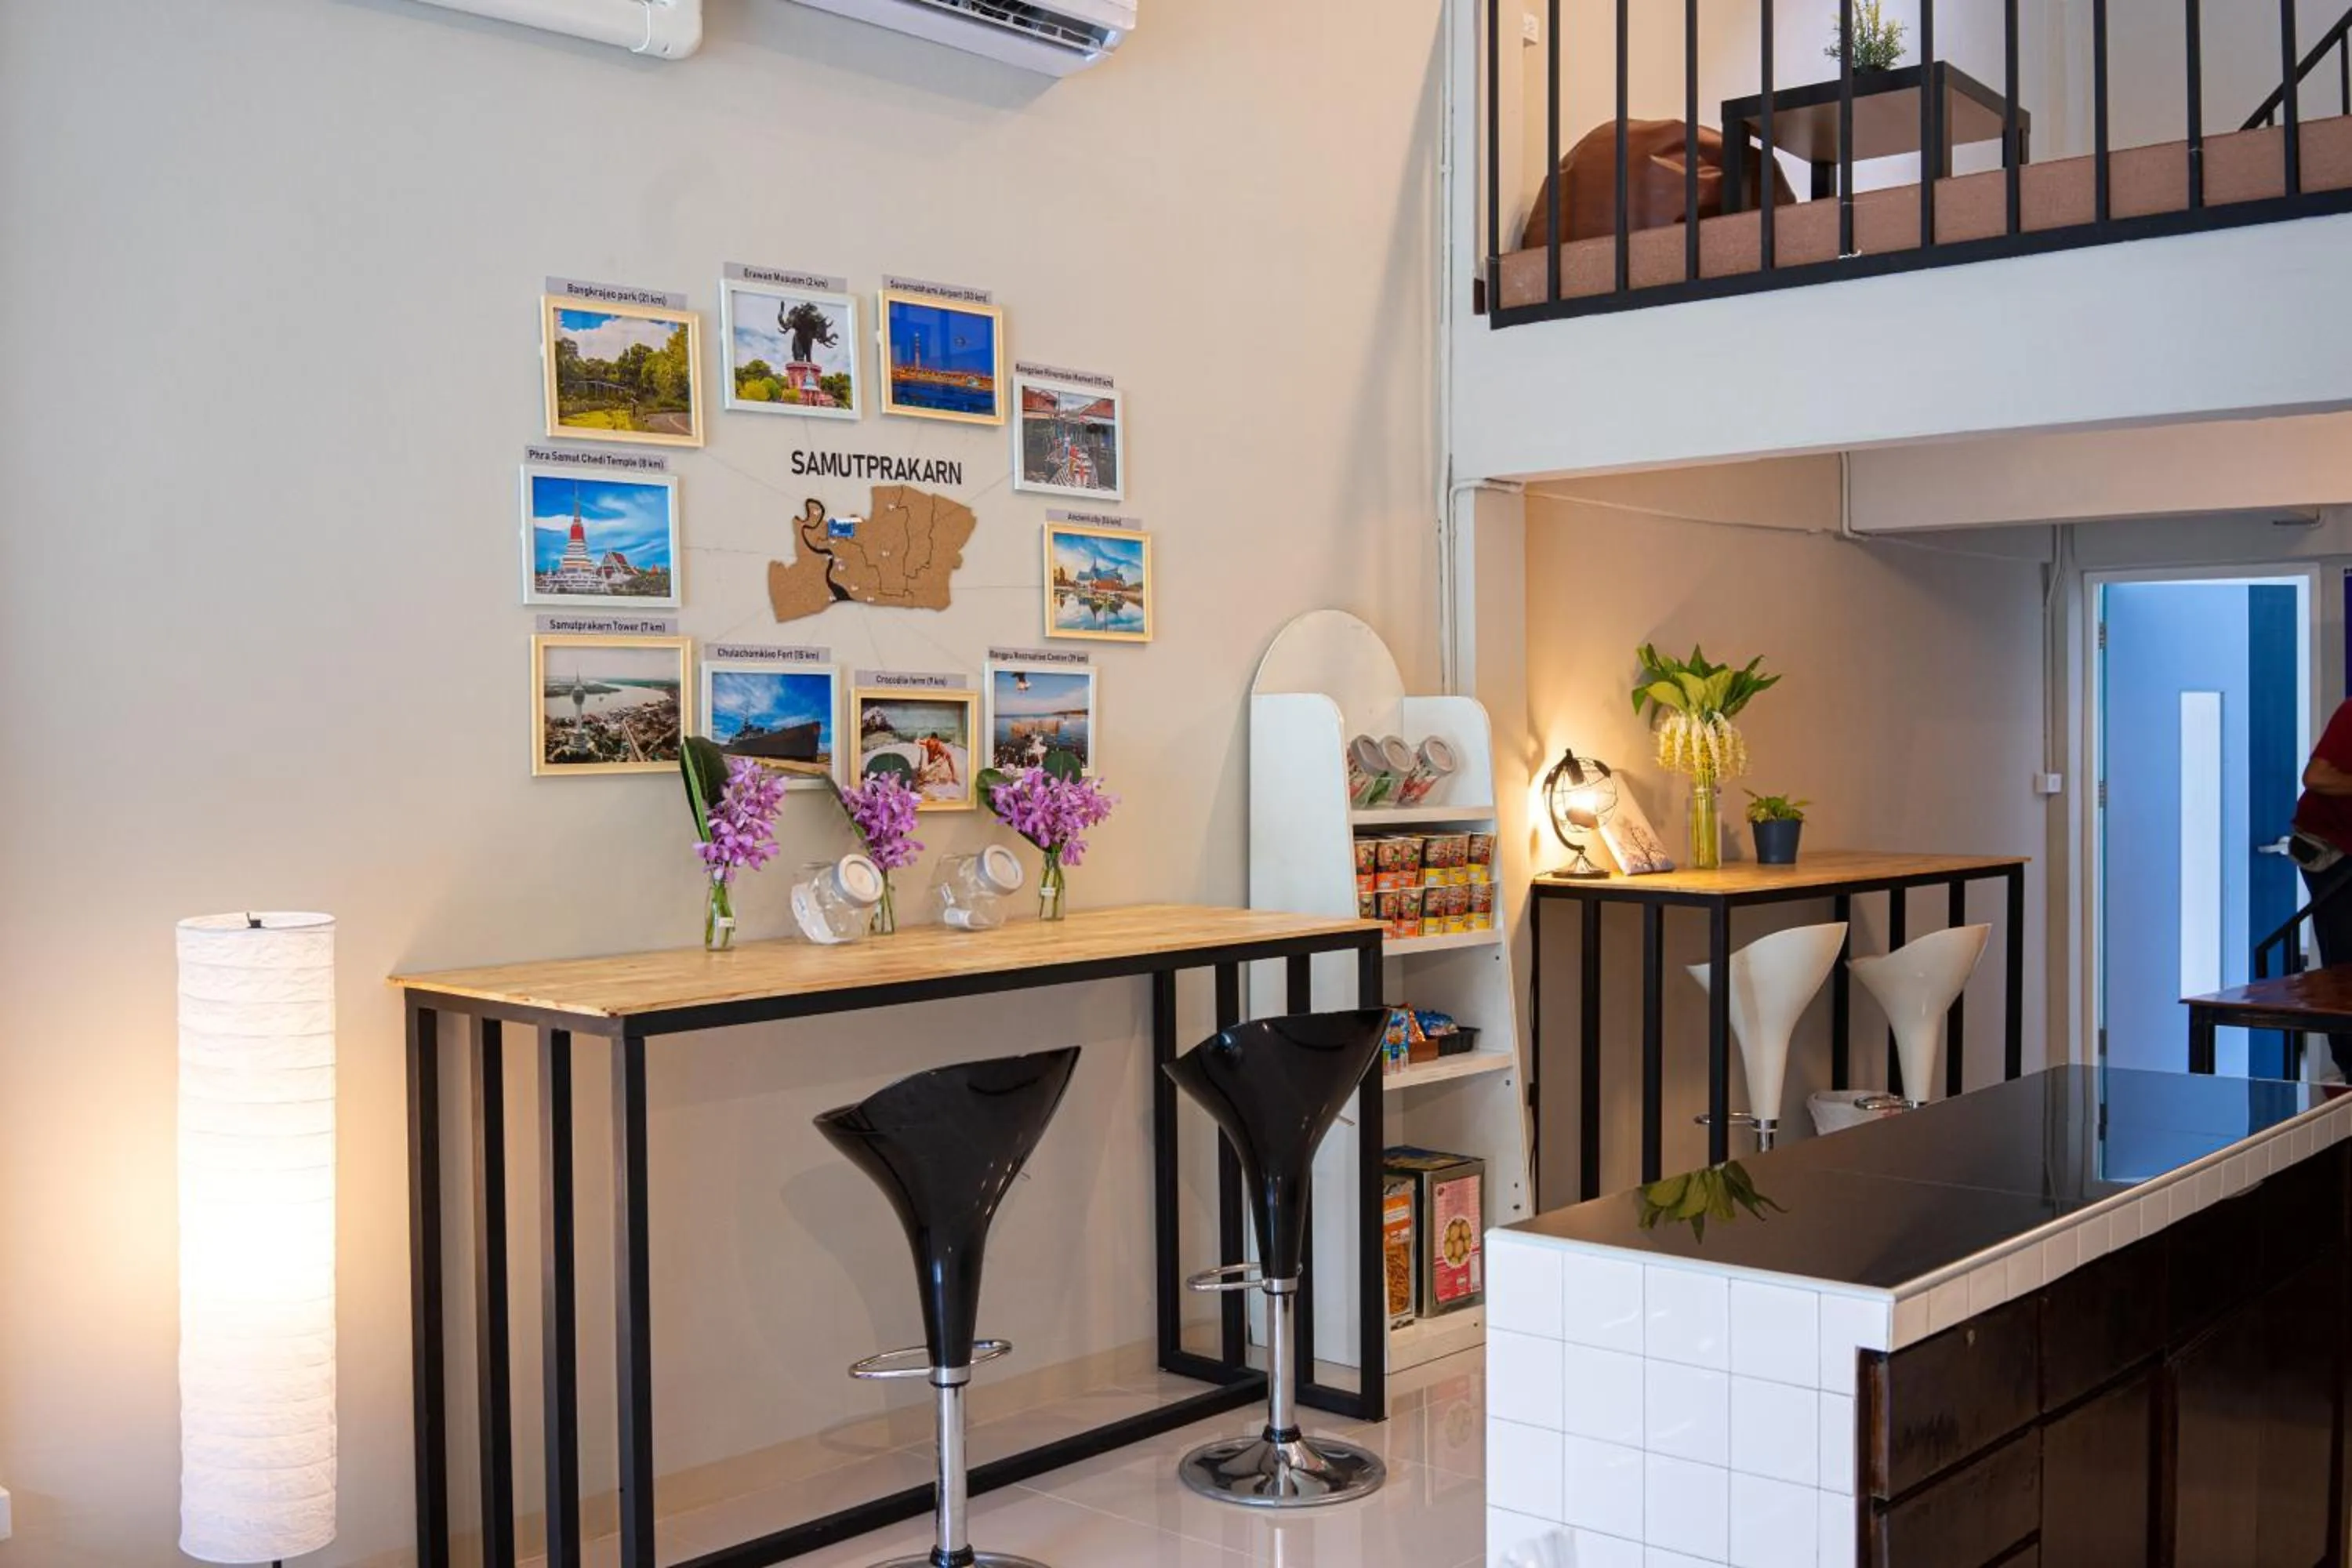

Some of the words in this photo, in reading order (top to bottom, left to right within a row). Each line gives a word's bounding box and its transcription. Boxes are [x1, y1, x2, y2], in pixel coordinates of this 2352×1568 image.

[618, 292, 637, 302] park
[650, 293, 667, 307] km)
[528, 450, 550, 460] Phra
[551, 451, 579, 463] Samut
[581, 454, 605, 464] Chedi
[606, 456, 637, 467] Temple
[648, 459, 664, 470] km)
[791, 449, 962, 485] SAMUTPRAKARN
[550, 619, 612, 631] Samutprakarn
[613, 620, 638, 631] Tower
[641, 622, 648, 633] (7
[649, 622, 666, 633] km)
[777, 648, 793, 659] Fort
[805, 651, 820, 662] km)
